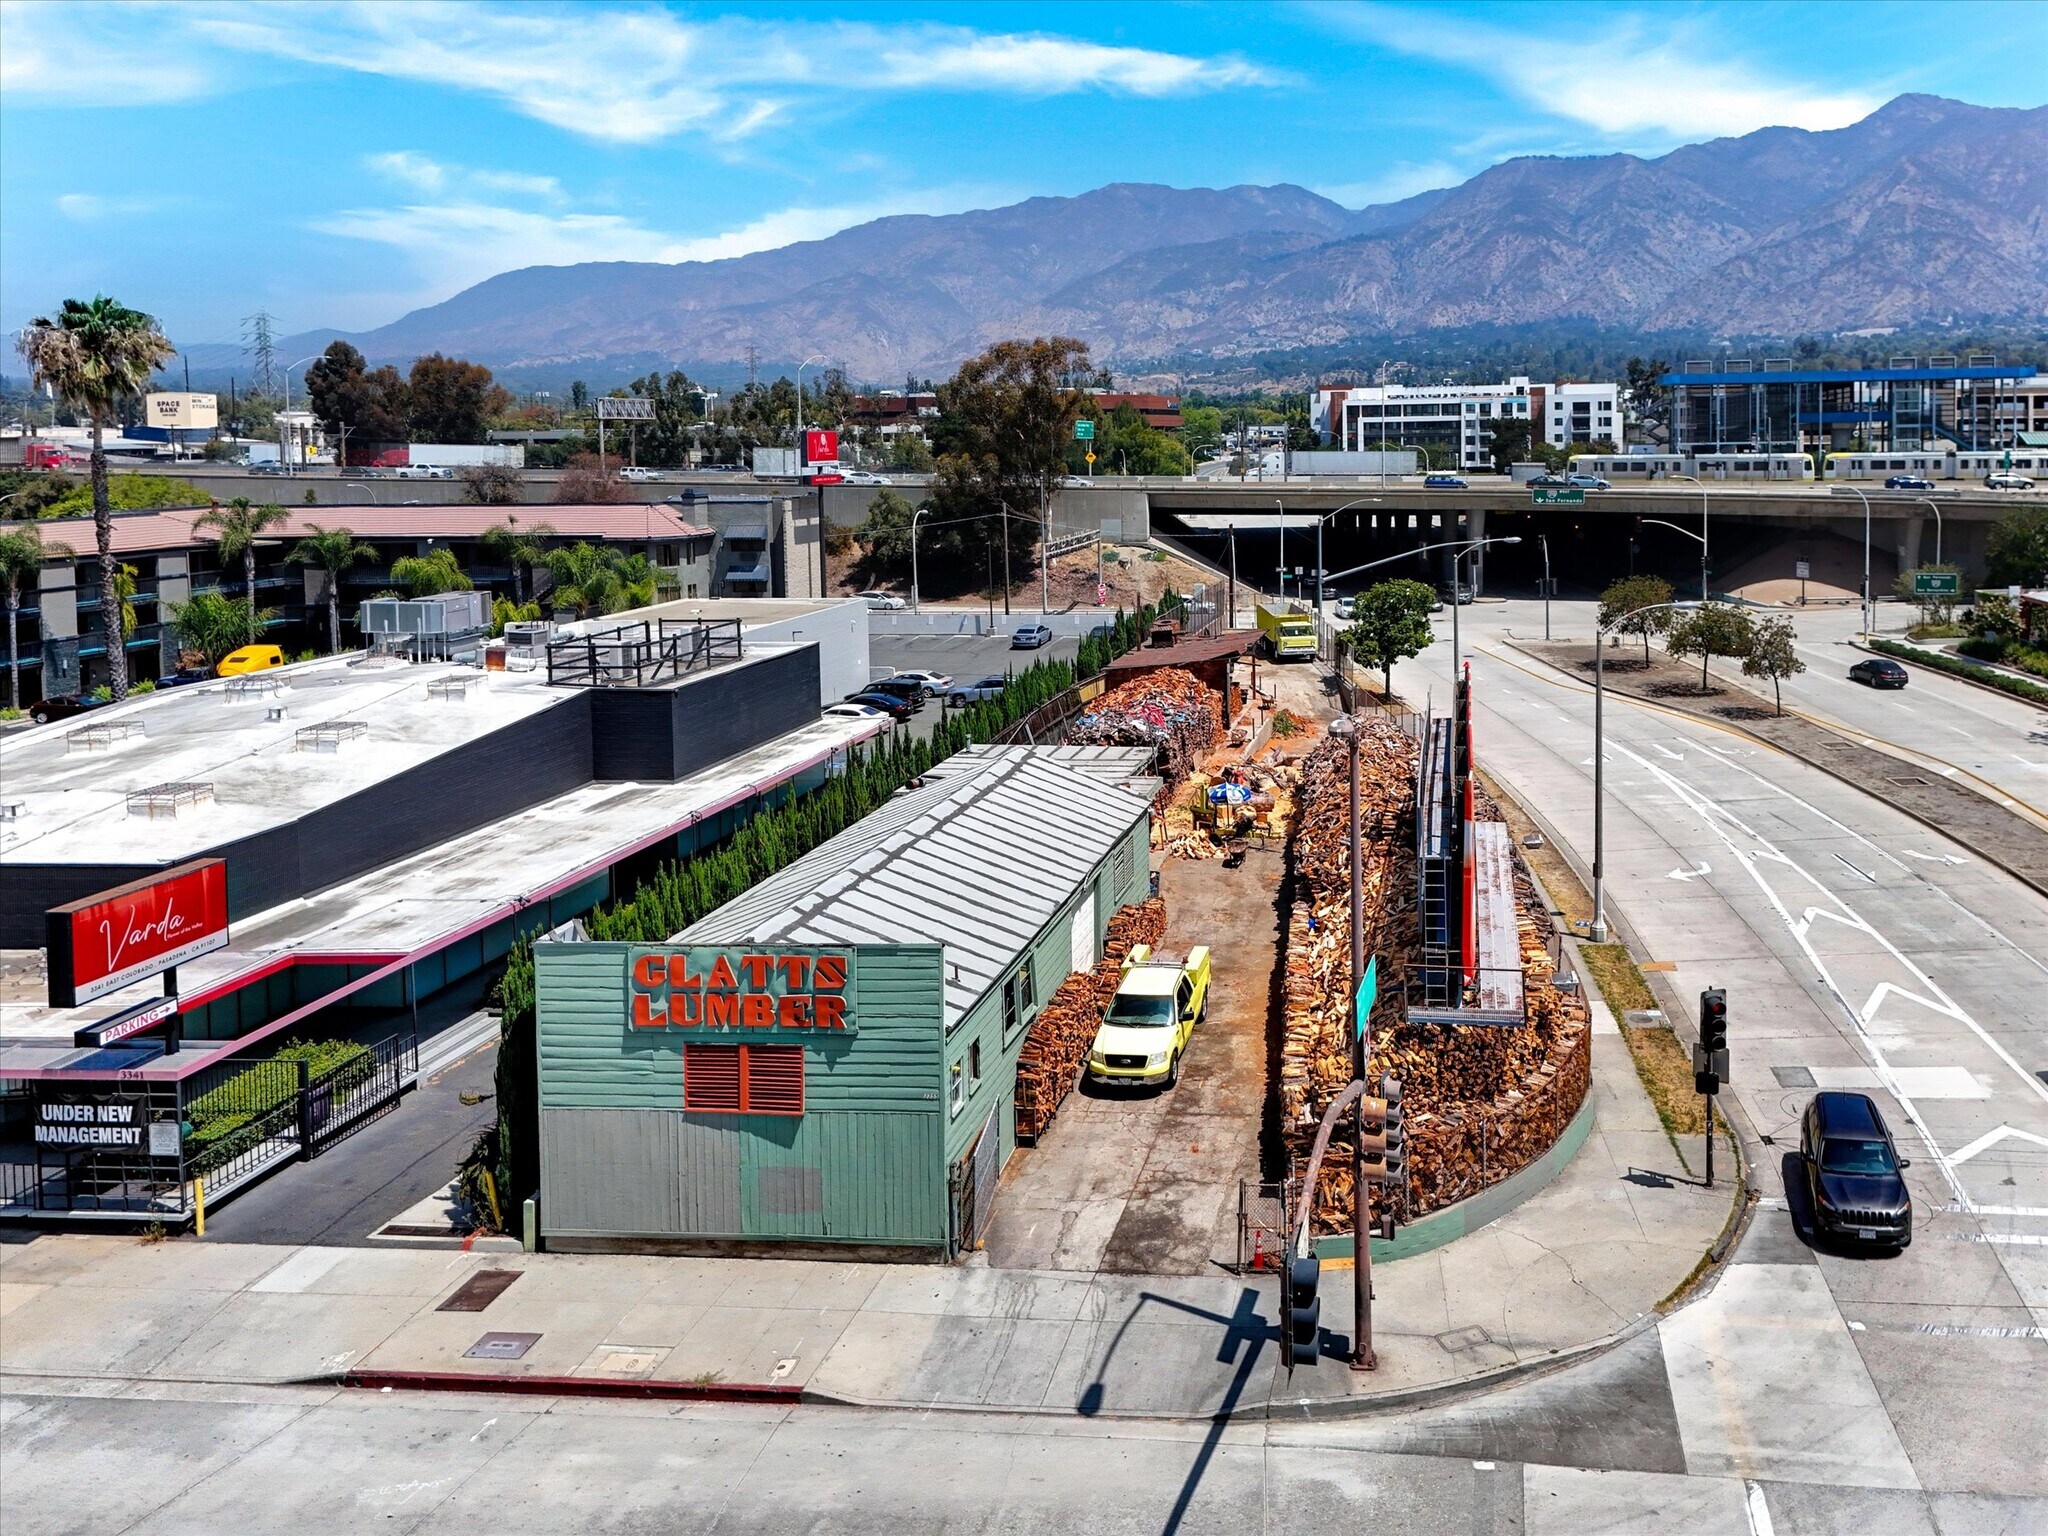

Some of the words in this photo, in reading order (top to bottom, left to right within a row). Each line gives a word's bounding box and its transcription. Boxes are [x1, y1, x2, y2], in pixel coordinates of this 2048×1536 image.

[99, 897, 185, 971] Varda
[90, 984, 104, 993] 3341
[106, 977, 119, 987] EAST
[121, 963, 154, 981] COLORADO
[158, 951, 187, 966] PASADENA
[634, 954, 848, 989] GLATTS
[105, 1010, 159, 1042] PARKING
[634, 993, 848, 1029] LUMBER
[121, 1071, 144, 1079] 3341
[42, 1104, 94, 1122] UNDER
[97, 1105, 133, 1123] NEW
[34, 1125, 142, 1144] MANAGEMENT
